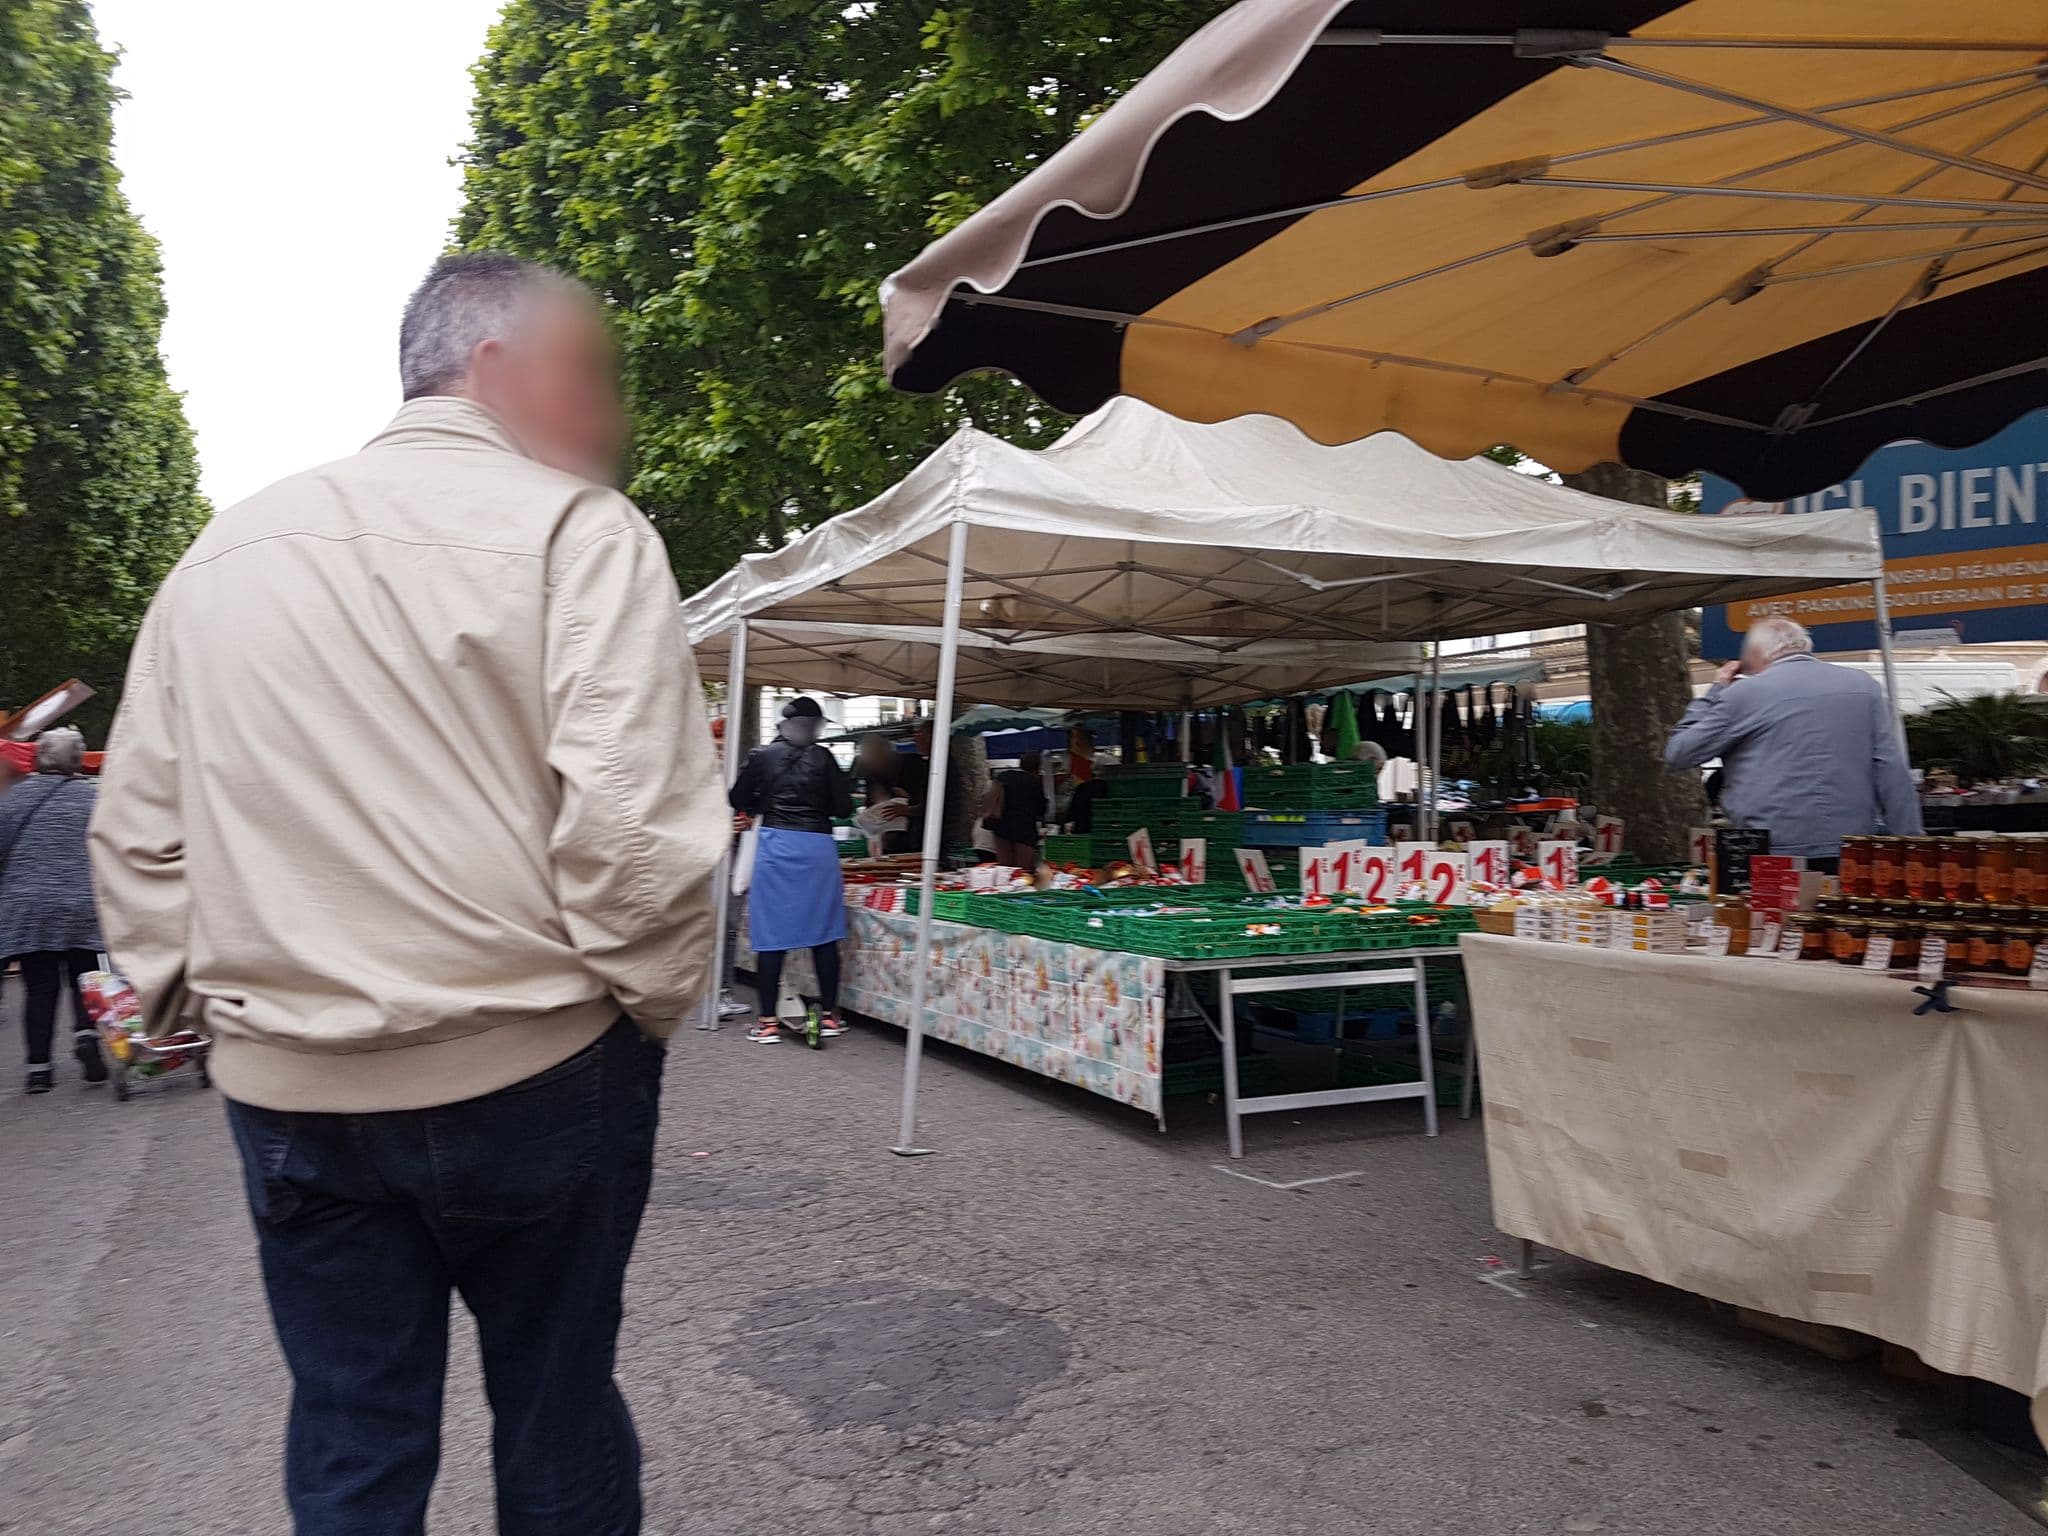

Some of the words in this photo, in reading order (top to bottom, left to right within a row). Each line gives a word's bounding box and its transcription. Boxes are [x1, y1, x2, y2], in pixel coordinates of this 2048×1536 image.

[1747, 601, 1794, 617] AVEC
[1797, 594, 1876, 613] PARKING
[1884, 586, 2003, 607] SOUTERRAIN
[2007, 585, 2034, 599] DE
[1306, 858, 1319, 894] 1
[1332, 852, 1350, 891] 1
[1365, 857, 1386, 904] 2
[1402, 850, 1423, 880] 1
[1474, 848, 1493, 883] 1
[1546, 847, 1563, 885] 1
